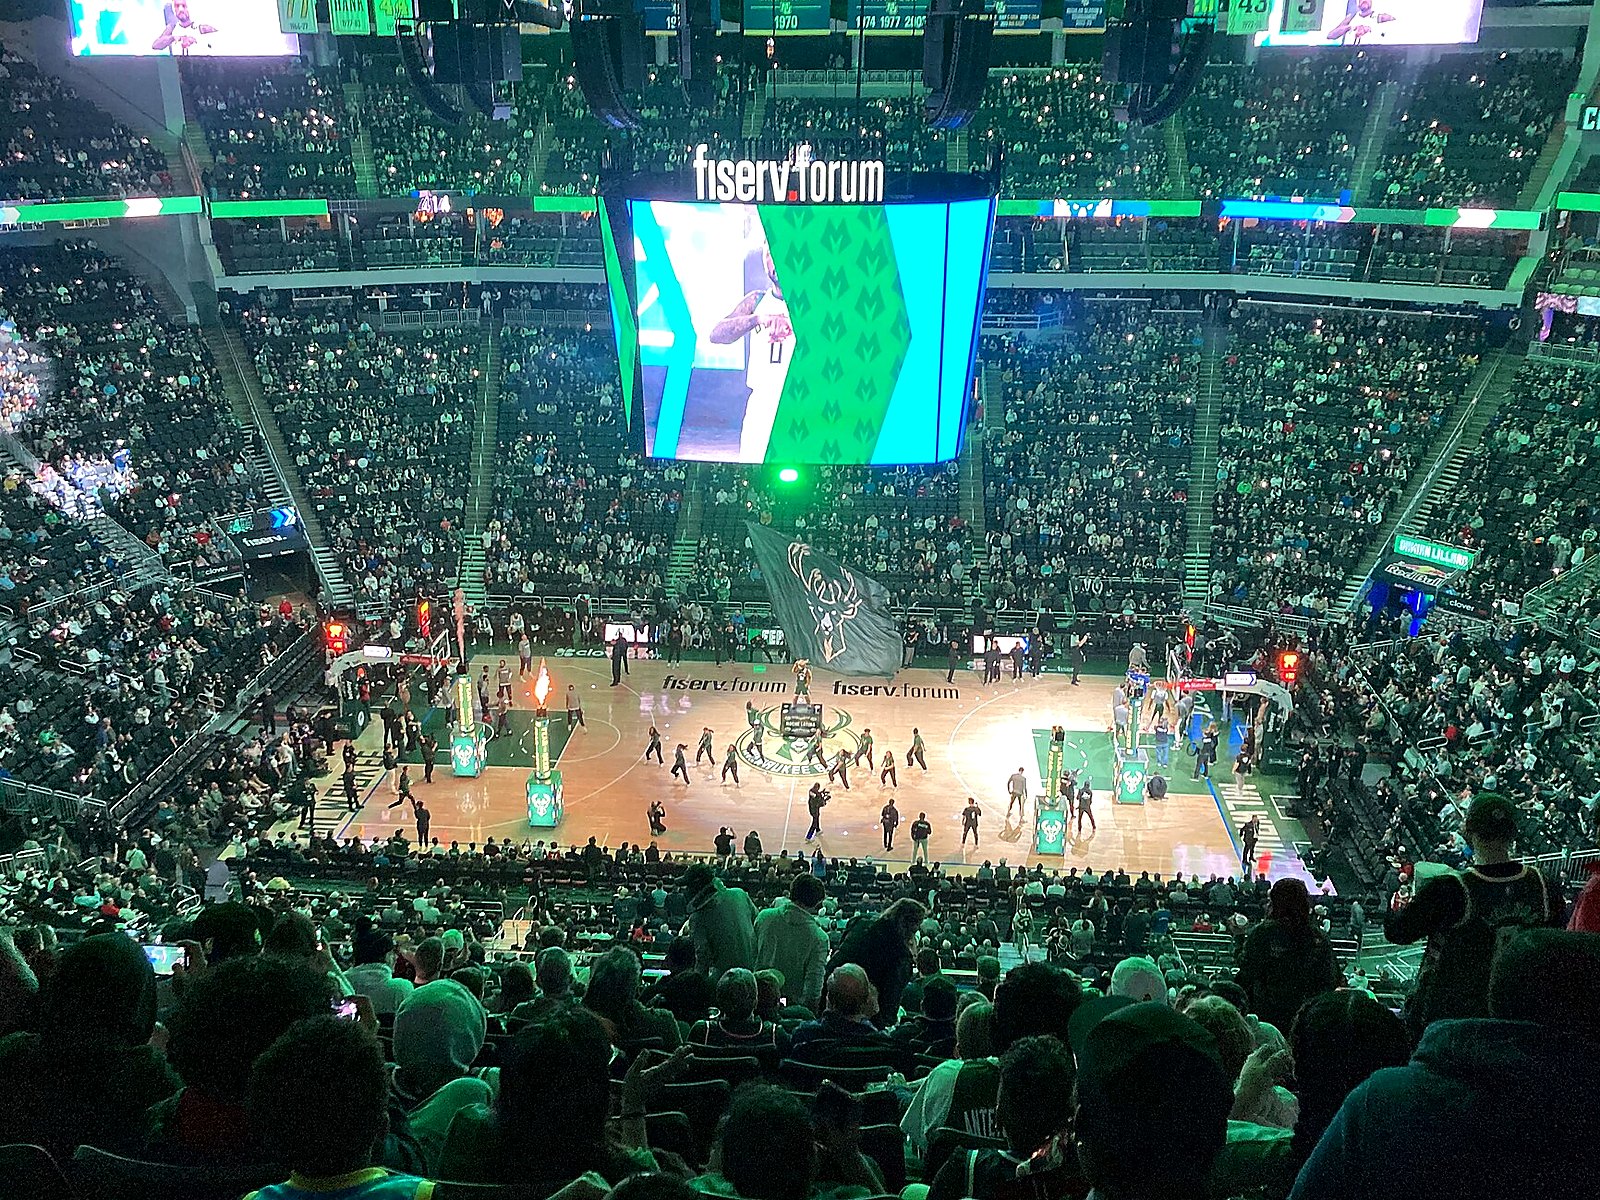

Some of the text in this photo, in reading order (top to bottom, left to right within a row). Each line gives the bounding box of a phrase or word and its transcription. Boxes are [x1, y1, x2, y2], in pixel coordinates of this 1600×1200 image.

[774, 15, 798, 30] 1970
[880, 15, 901, 29] 1977
[1431, 548, 1469, 567] LILLARD
[205, 565, 229, 576] clover
[1449, 599, 1475, 612] clover
[575, 648, 605, 657] clo
